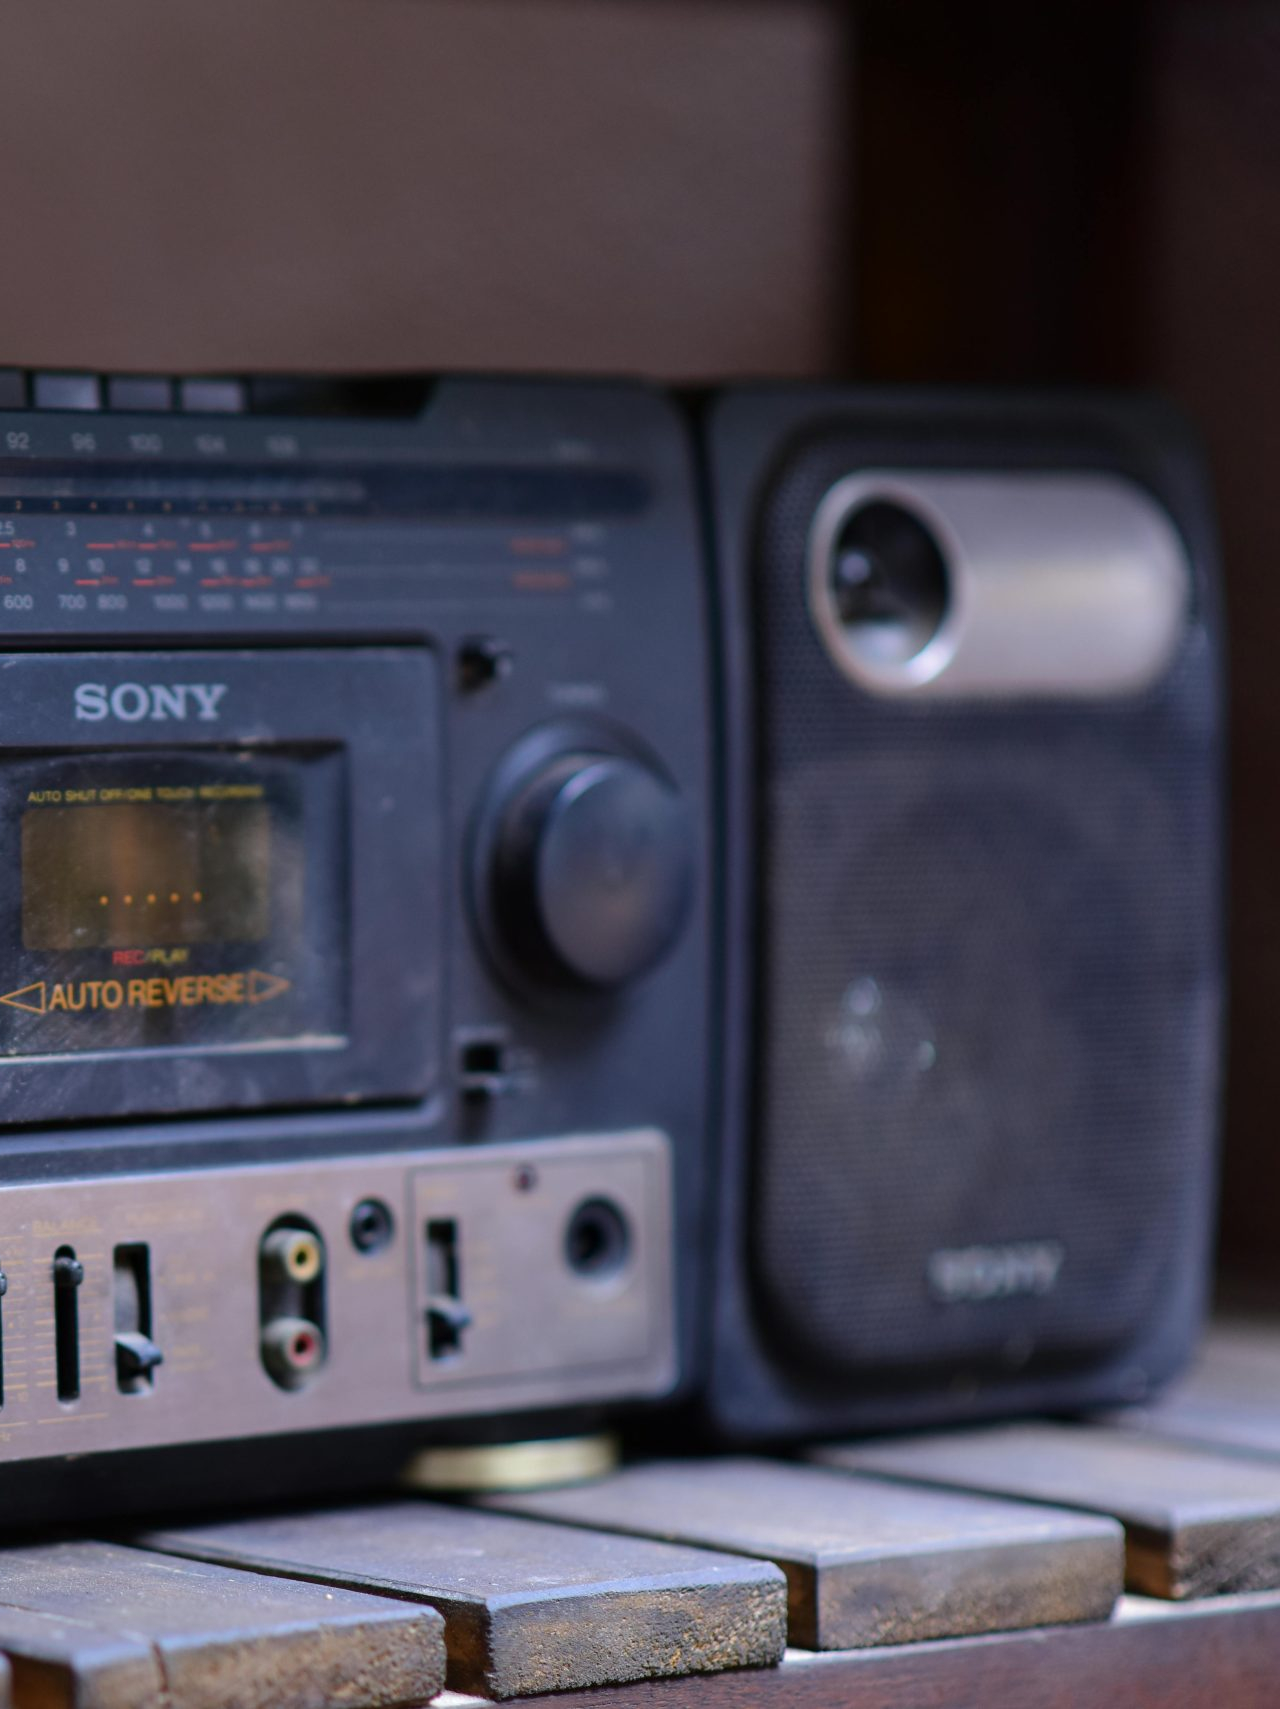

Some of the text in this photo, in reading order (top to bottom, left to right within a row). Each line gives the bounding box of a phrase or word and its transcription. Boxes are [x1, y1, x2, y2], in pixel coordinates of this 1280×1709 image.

[6, 431, 29, 449] 92
[15, 558, 26, 573] 8
[3, 594, 34, 611] 600
[74, 683, 227, 721] SONY
[27, 790, 62, 802] AUTO
[65, 789, 97, 801] SHUT
[48, 973, 246, 1010] AUTO REVERSE
